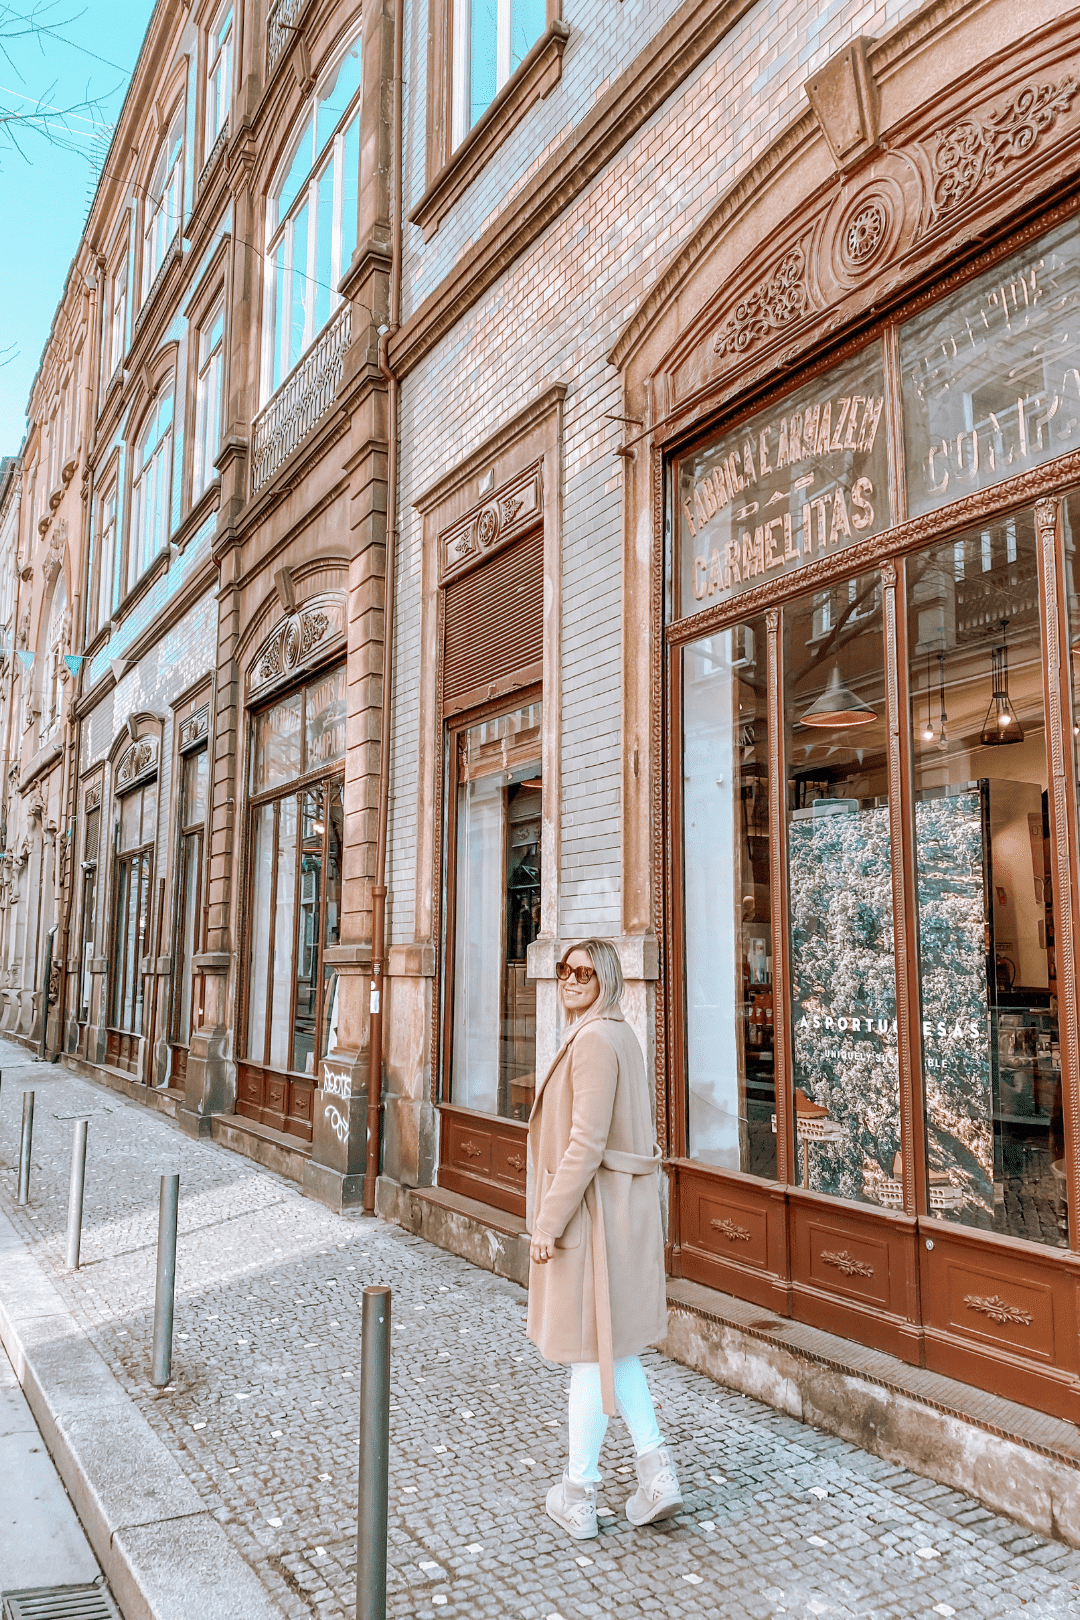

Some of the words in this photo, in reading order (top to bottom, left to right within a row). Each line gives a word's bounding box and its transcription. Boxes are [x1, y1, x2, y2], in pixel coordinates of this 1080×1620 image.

[760, 425, 773, 478] E
[692, 476, 875, 601] CARMELITAS
[800, 1014, 980, 1039] ASPORTUESAS
[824, 1049, 870, 1063] UNIQUELY
